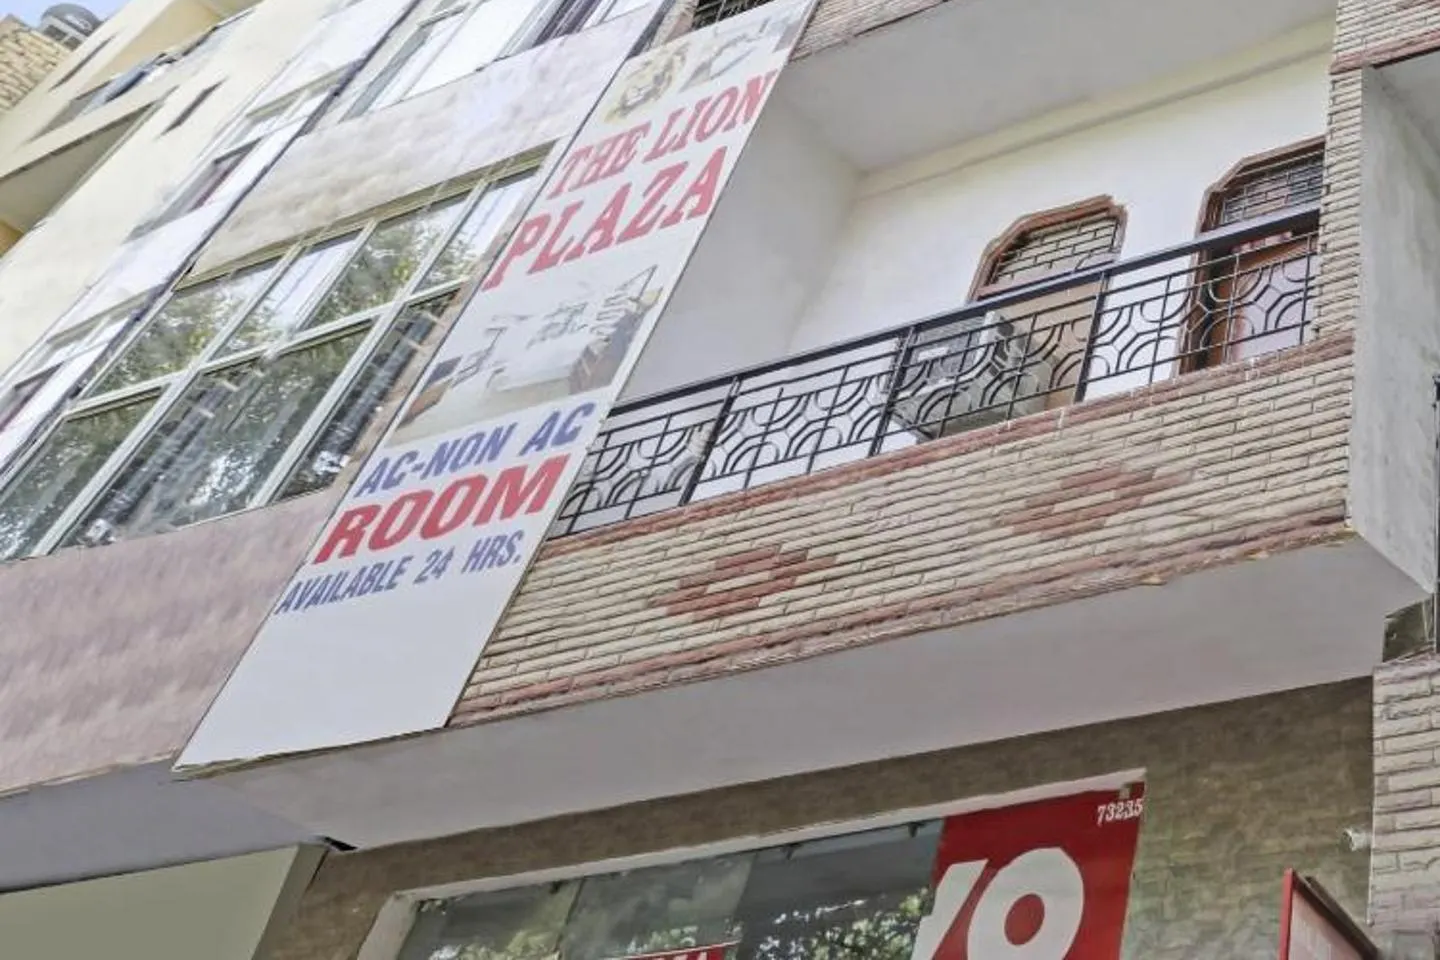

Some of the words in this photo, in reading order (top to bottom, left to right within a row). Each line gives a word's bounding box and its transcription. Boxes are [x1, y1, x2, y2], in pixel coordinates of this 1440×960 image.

[546, 121, 652, 200] THE
[642, 69, 778, 164] LION
[481, 146, 728, 293] PLAZA
[354, 422, 517, 498] AC-NON
[519, 402, 595, 457] AC
[313, 453, 571, 565] ROOM
[274, 555, 413, 615] AVAILABLE
[412, 546, 455, 586] 24
